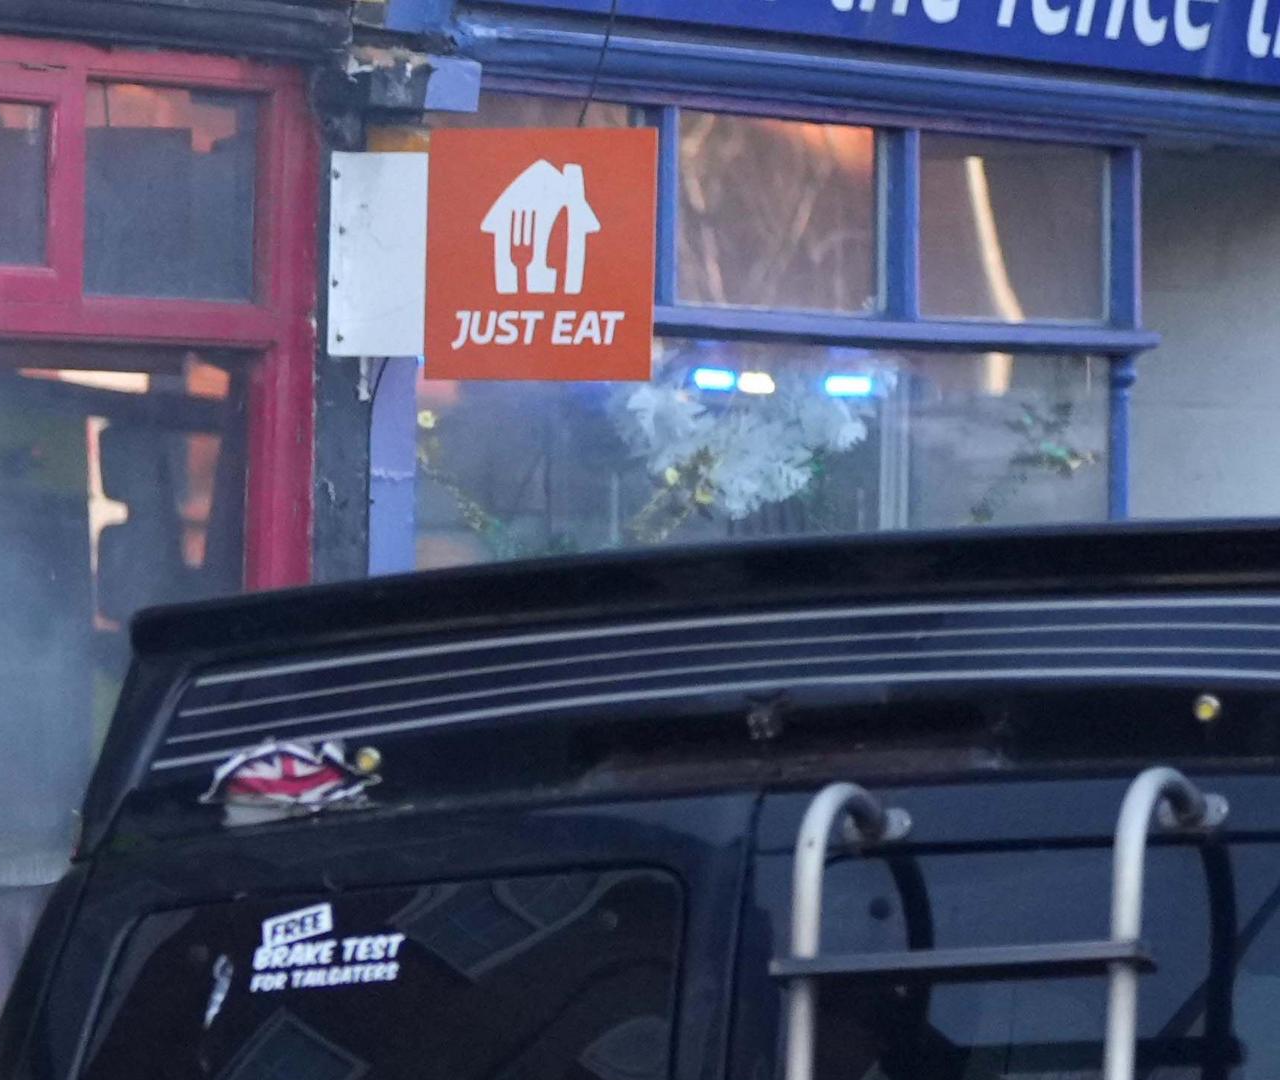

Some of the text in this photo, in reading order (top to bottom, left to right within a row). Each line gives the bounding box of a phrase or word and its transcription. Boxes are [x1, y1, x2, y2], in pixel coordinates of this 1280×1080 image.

[451, 310, 626, 350] JUST EAT
[270, 910, 323, 940] FREE
[252, 932, 407, 971] BRAKE TEST
[249, 960, 401, 993] FOR TAILGATERS
